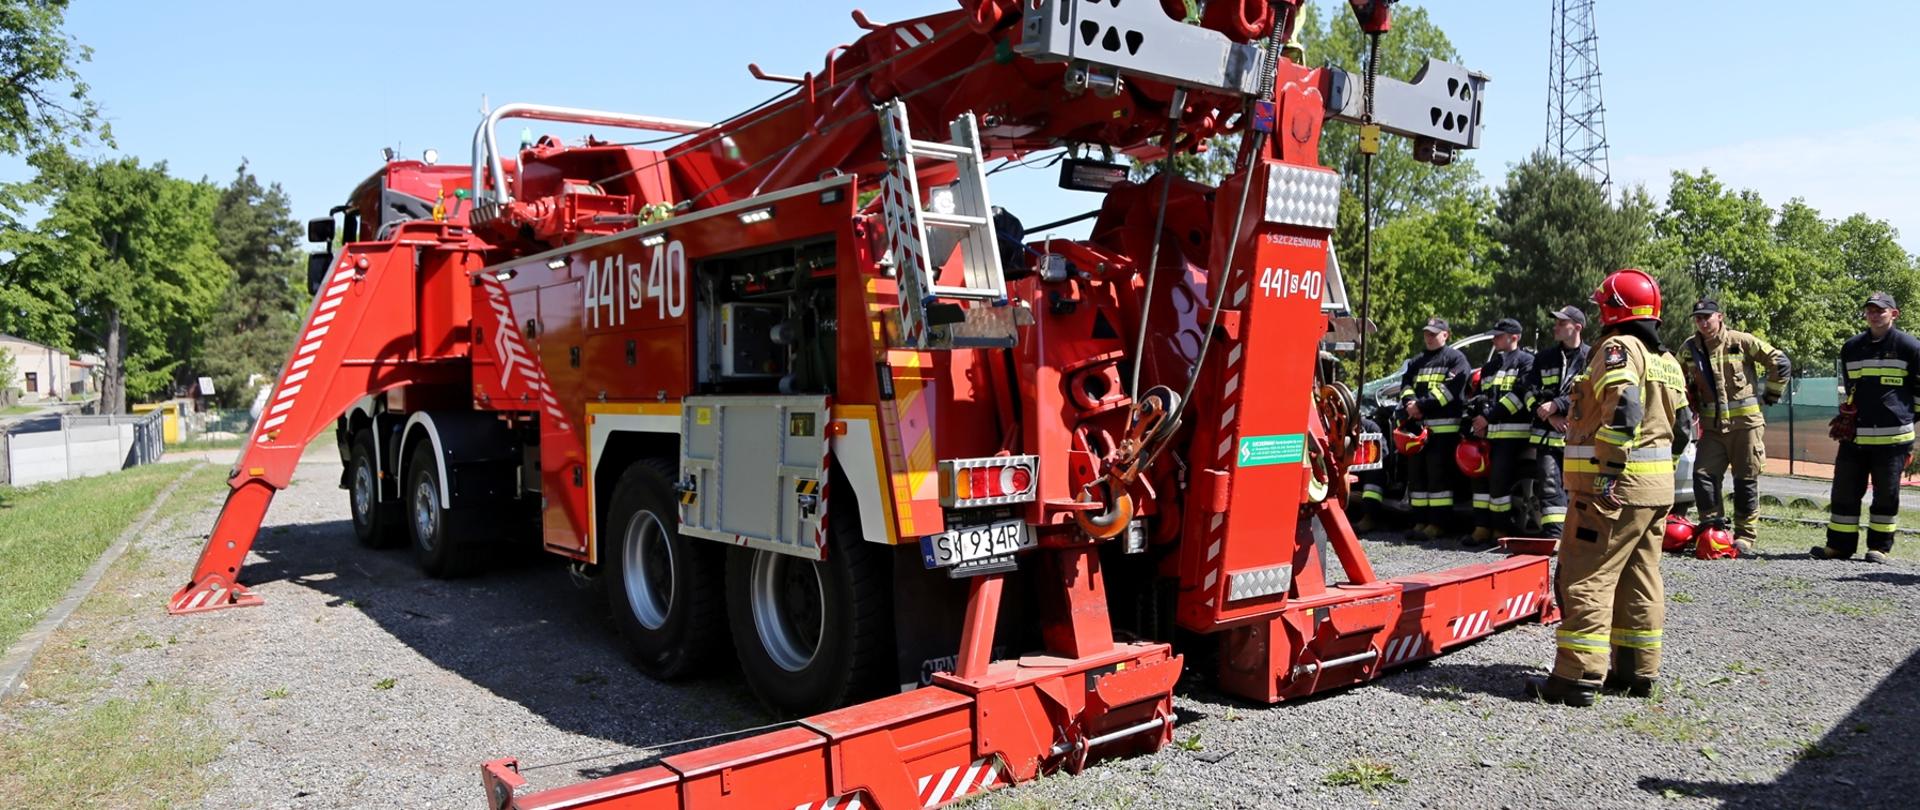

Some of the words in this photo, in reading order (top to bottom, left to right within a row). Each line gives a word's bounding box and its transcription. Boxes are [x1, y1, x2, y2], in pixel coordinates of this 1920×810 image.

[584, 254, 624, 329] 441
[630, 266, 641, 307] S
[647, 240, 686, 320] 40
[1259, 267, 1290, 298] 441
[1300, 270, 1321, 300] 40
[970, 523, 1030, 556] 934RJ
